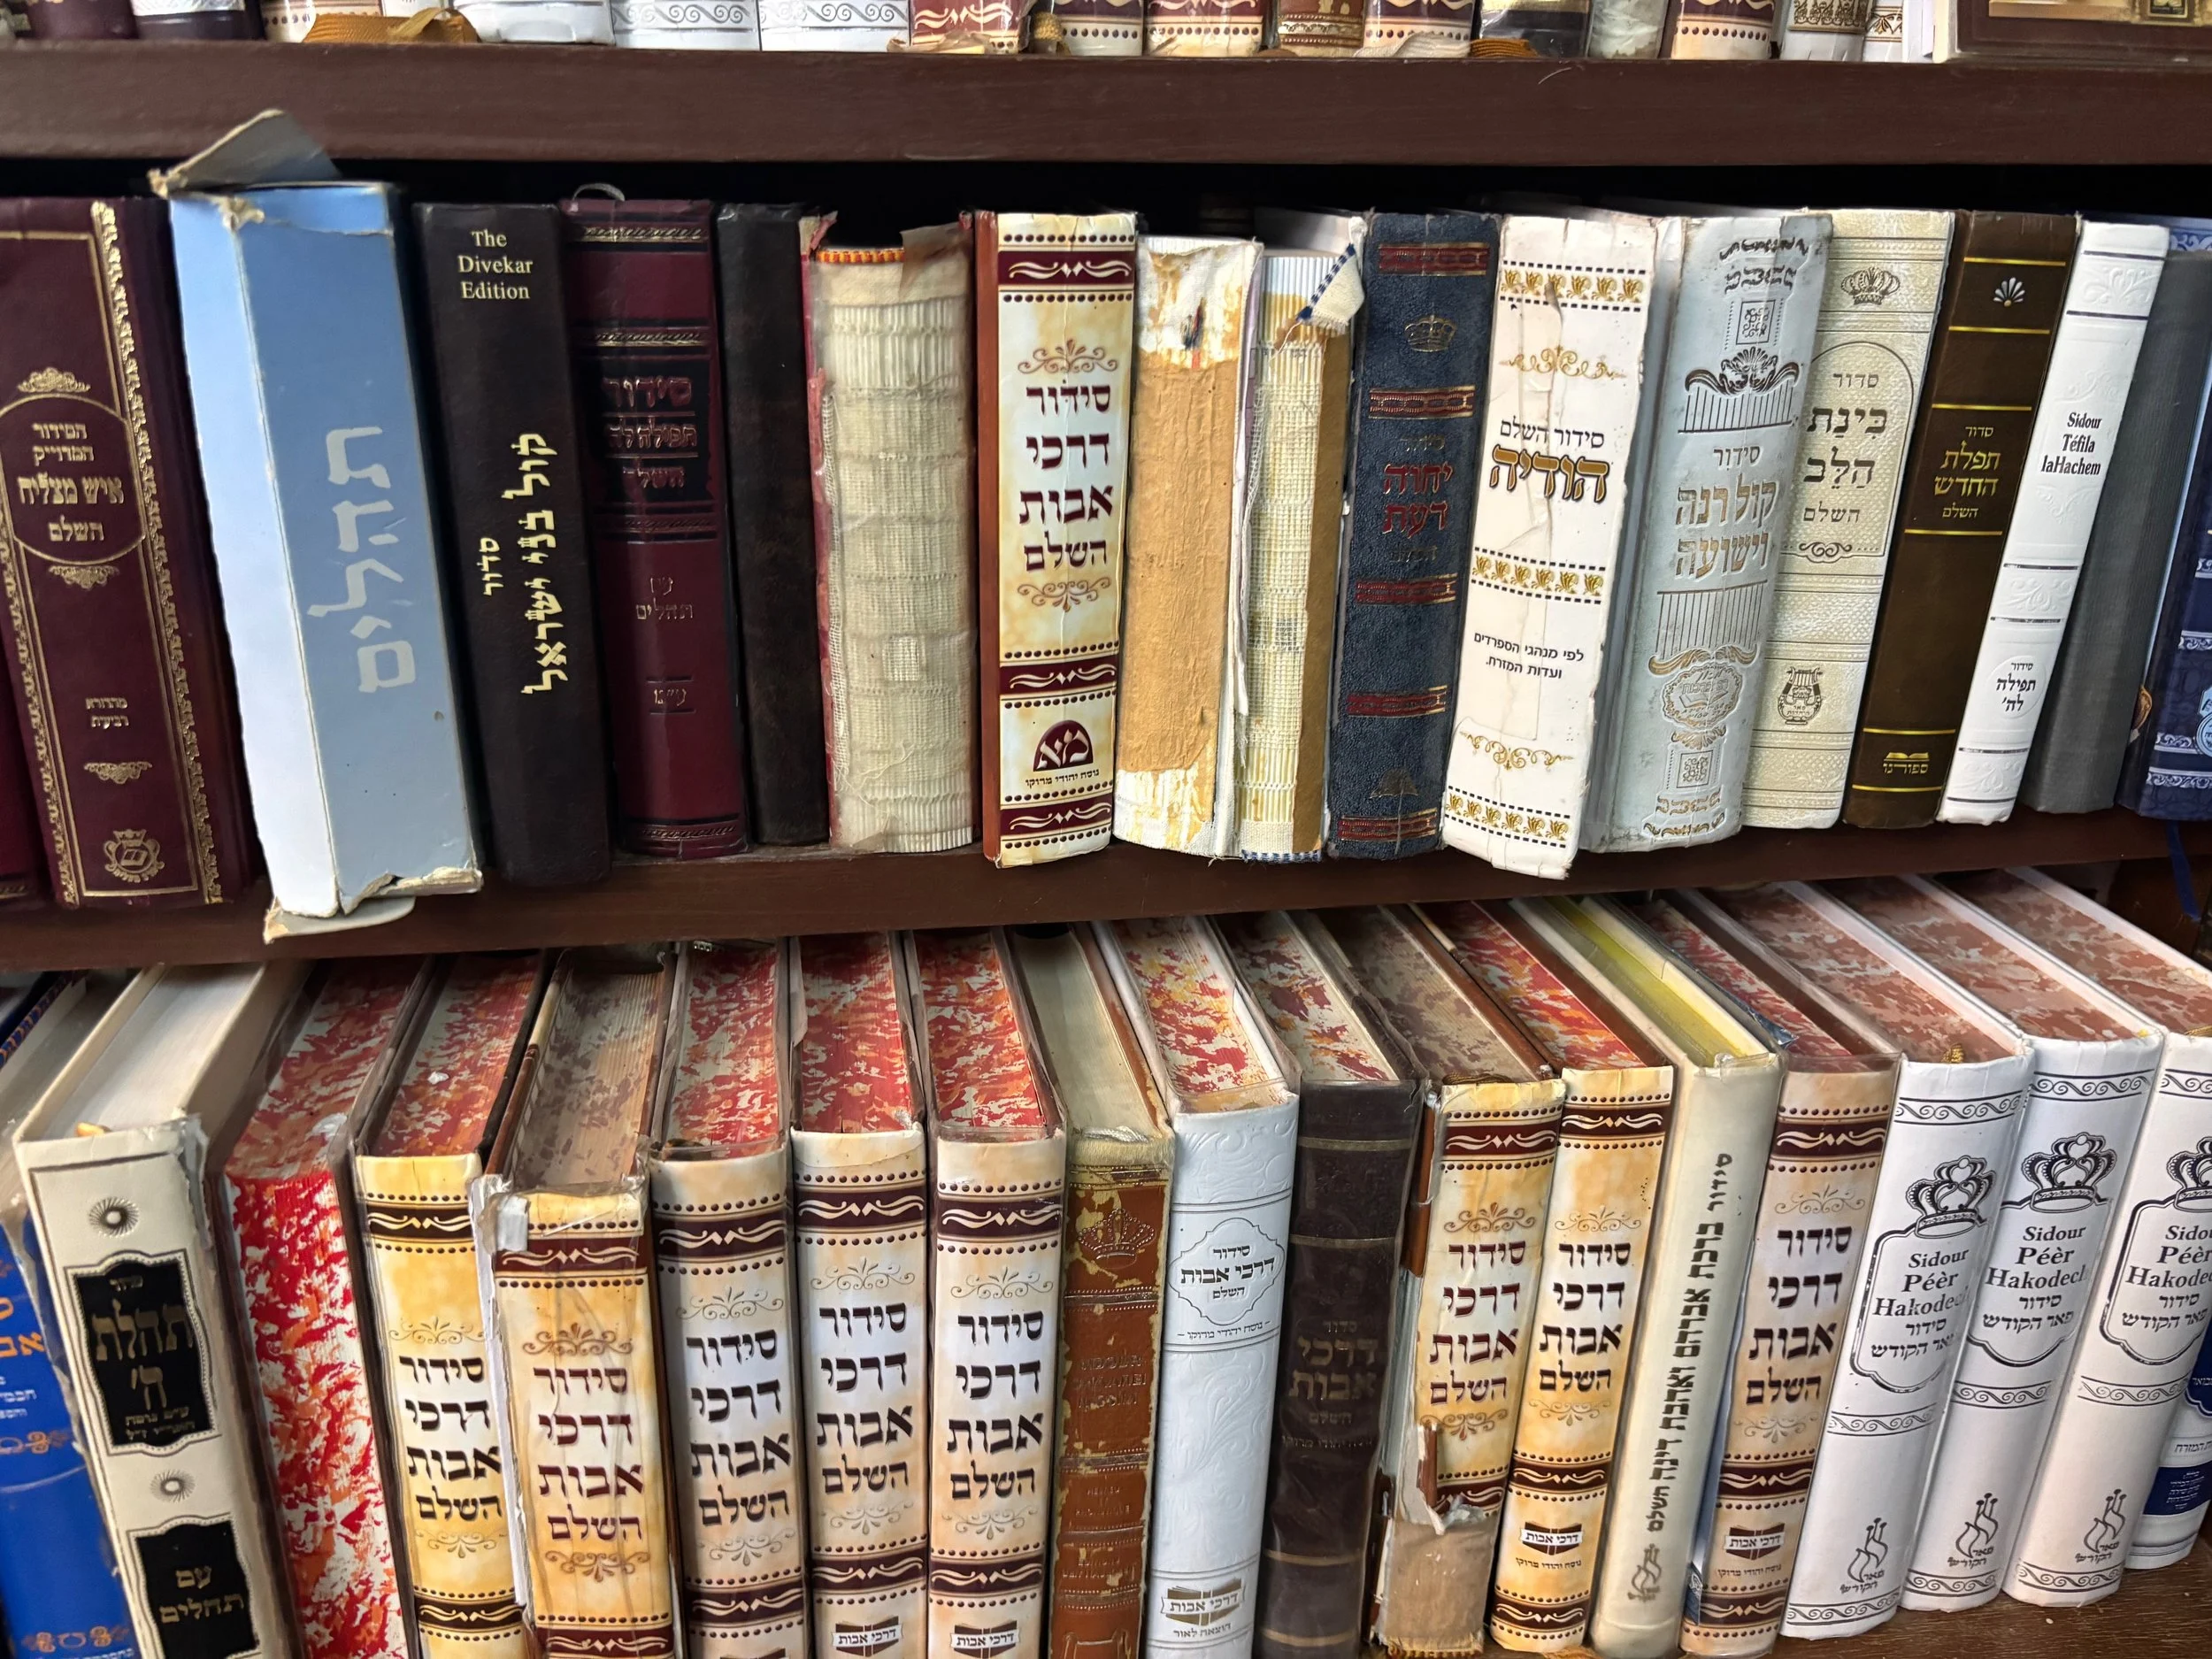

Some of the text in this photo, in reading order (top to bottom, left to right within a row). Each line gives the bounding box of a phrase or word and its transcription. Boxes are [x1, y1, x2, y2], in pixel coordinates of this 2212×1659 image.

[472, 229, 508, 248] The
[457, 254, 534, 274] Divekar
[460, 280, 532, 300] Edition
[602, 376, 692, 408] סידור
[1833, 373, 1879, 388] סדור
[1026, 384, 1111, 416] סידור
[32, 423, 88, 439] הסידור
[1501, 416, 1605, 449] סידור השלם
[1965, 426, 1994, 438] סדור
[2067, 411, 2102, 429] Sidour
[1026, 433, 1110, 470] דרכי
[1714, 446, 1761, 467] סידור
[1939, 440, 2001, 471] תפלת
[2062, 433, 2096, 453] Téfila
[1489, 443, 1610, 503] הודיה
[2040, 454, 2101, 476] laHachem
[17, 472, 125, 504] איש מצליח
[1676, 473, 1778, 528] קול רנה
[1934, 475, 2000, 496] החדש
[1019, 485, 1114, 524] אבות
[1382, 500, 1448, 539] דעת
[1803, 501, 1861, 523] השלם
[1942, 502, 1979, 518] השלם
[48, 515, 104, 541] השלם
[307, 426, 416, 694] תהלים
[476, 537, 504, 596] סדור
[501, 433, 569, 695] קול בני ישראל
[1024, 531, 1107, 572] השלם
[1676, 531, 1770, 580] וישועה
[635, 597, 693, 620] תהלים
[1473, 633, 1585, 662] לפי מנהגי הספרדים
[1527, 665, 1563, 679] ועדות
[2010, 662, 2034, 672] סידור
[1996, 672, 2037, 693] תפילה
[1025, 769, 1100, 789] נוסח יהודי מרוקו
[1777, 1225, 1853, 1257] סידור
[2023, 1225, 2086, 1241] Sidour
[1213, 1245, 1251, 1260] סידור
[1448, 1240, 1526, 1269] סידור
[1559, 1243, 1632, 1269] סידור
[1909, 1248, 1970, 1269] Sidour
[2015, 1247, 2075, 1265] Péèr
[1180, 1257, 1276, 1284] דרכי אבות
[1901, 1271, 1960, 1293] Péèr
[1212, 1286, 1246, 1300] השלם
[1443, 1282, 1521, 1317] דרכי
[1553, 1282, 1625, 1311] דרכי
[1768, 1272, 1843, 1310] דרכי
[2019, 1294, 2062, 1310] סידור
[2159, 1294, 2200, 1309] סידור
[91, 1298, 194, 1362] תהלת
[819, 1302, 908, 1339] סידור
[957, 1310, 1045, 1345] סידור
[1187, 1322, 1263, 1340] נוסח יהודי מרוקו
[1906, 1318, 1947, 1335] סידור
[1983, 1310, 2075, 1334] פאר הקודש
[2122, 1308, 2208, 1333] פאר הקודש
[686, 1329, 778, 1367] סידור
[1297, 1335, 1379, 1368] דרכי
[1429, 1328, 1519, 1364] אבות
[1539, 1324, 1624, 1356] אבות
[1646, 1153, 1732, 1532] סידור ברכת אברהם ואהבת דינה השלם
[1748, 1322, 1838, 1361] אבות
[1871, 1342, 1929, 1361] הקודש
[399, 1356, 484, 1385] סידור
[533, 1366, 627, 1395] סידור
[820, 1352, 907, 1392] דרכי
[956, 1360, 1041, 1400] דרכי
[1288, 1369, 1378, 1401] אבות
[1540, 1359, 1611, 1393] השלם
[691, 1379, 781, 1423] דרכי
[1430, 1370, 1508, 1405] השלם
[1746, 1366, 1822, 1406] השלם
[404, 1398, 489, 1432] דרכי
[817, 1405, 913, 1448] אבות
[538, 1414, 633, 1447] דרכי
[947, 1412, 1045, 1455] אבות
[407, 1444, 502, 1482] אבות
[690, 1432, 792, 1479] אבות
[537, 1463, 645, 1500] אבות
[822, 1454, 910, 1494] השלם
[950, 1460, 1037, 1501] השלם
[415, 1485, 503, 1522] השלם
[699, 1485, 790, 1526] השלם
[548, 1504, 642, 1541] השלם
[1525, 1532, 1579, 1544] דרכי אבות
[1729, 1534, 1781, 1548] דרכי אבות
[176, 1565, 212, 1589] עם
[159, 1594, 245, 1624] תהלים
[1170, 1593, 1239, 1613] דרכי אבות
[838, 1629, 896, 1645] דרכי אבות
[956, 1632, 1015, 1646] דרכי אבות
